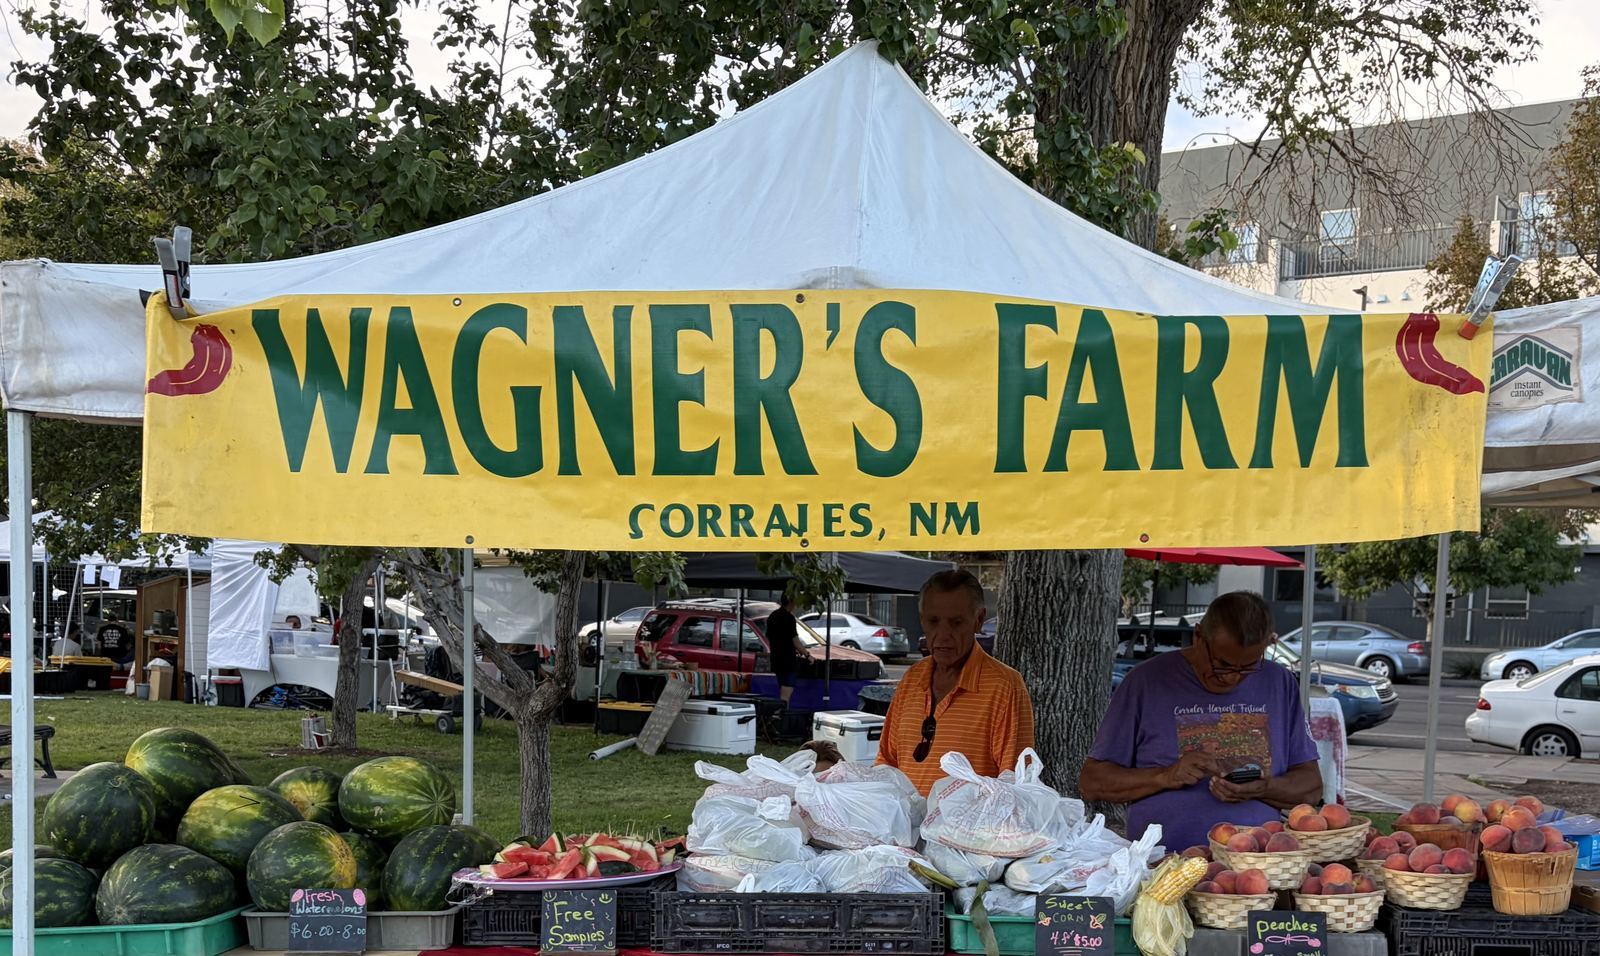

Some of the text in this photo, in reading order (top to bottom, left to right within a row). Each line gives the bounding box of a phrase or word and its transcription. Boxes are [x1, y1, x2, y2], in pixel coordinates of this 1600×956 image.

[253, 302, 1367, 477] WAGNER'S FARM
[1514, 381, 1541, 389] instant
[1510, 389, 1544, 400] canopies
[912, 502, 979, 535] NM
[1174, 703, 1266, 715] Corrales Harvest Festival
[304, 888, 344, 904] Fresh
[1045, 897, 1098, 911] Sweet
[553, 901, 595, 925] Free
[1053, 912, 1084, 923] CORN
[548, 925, 605, 946] Samples
